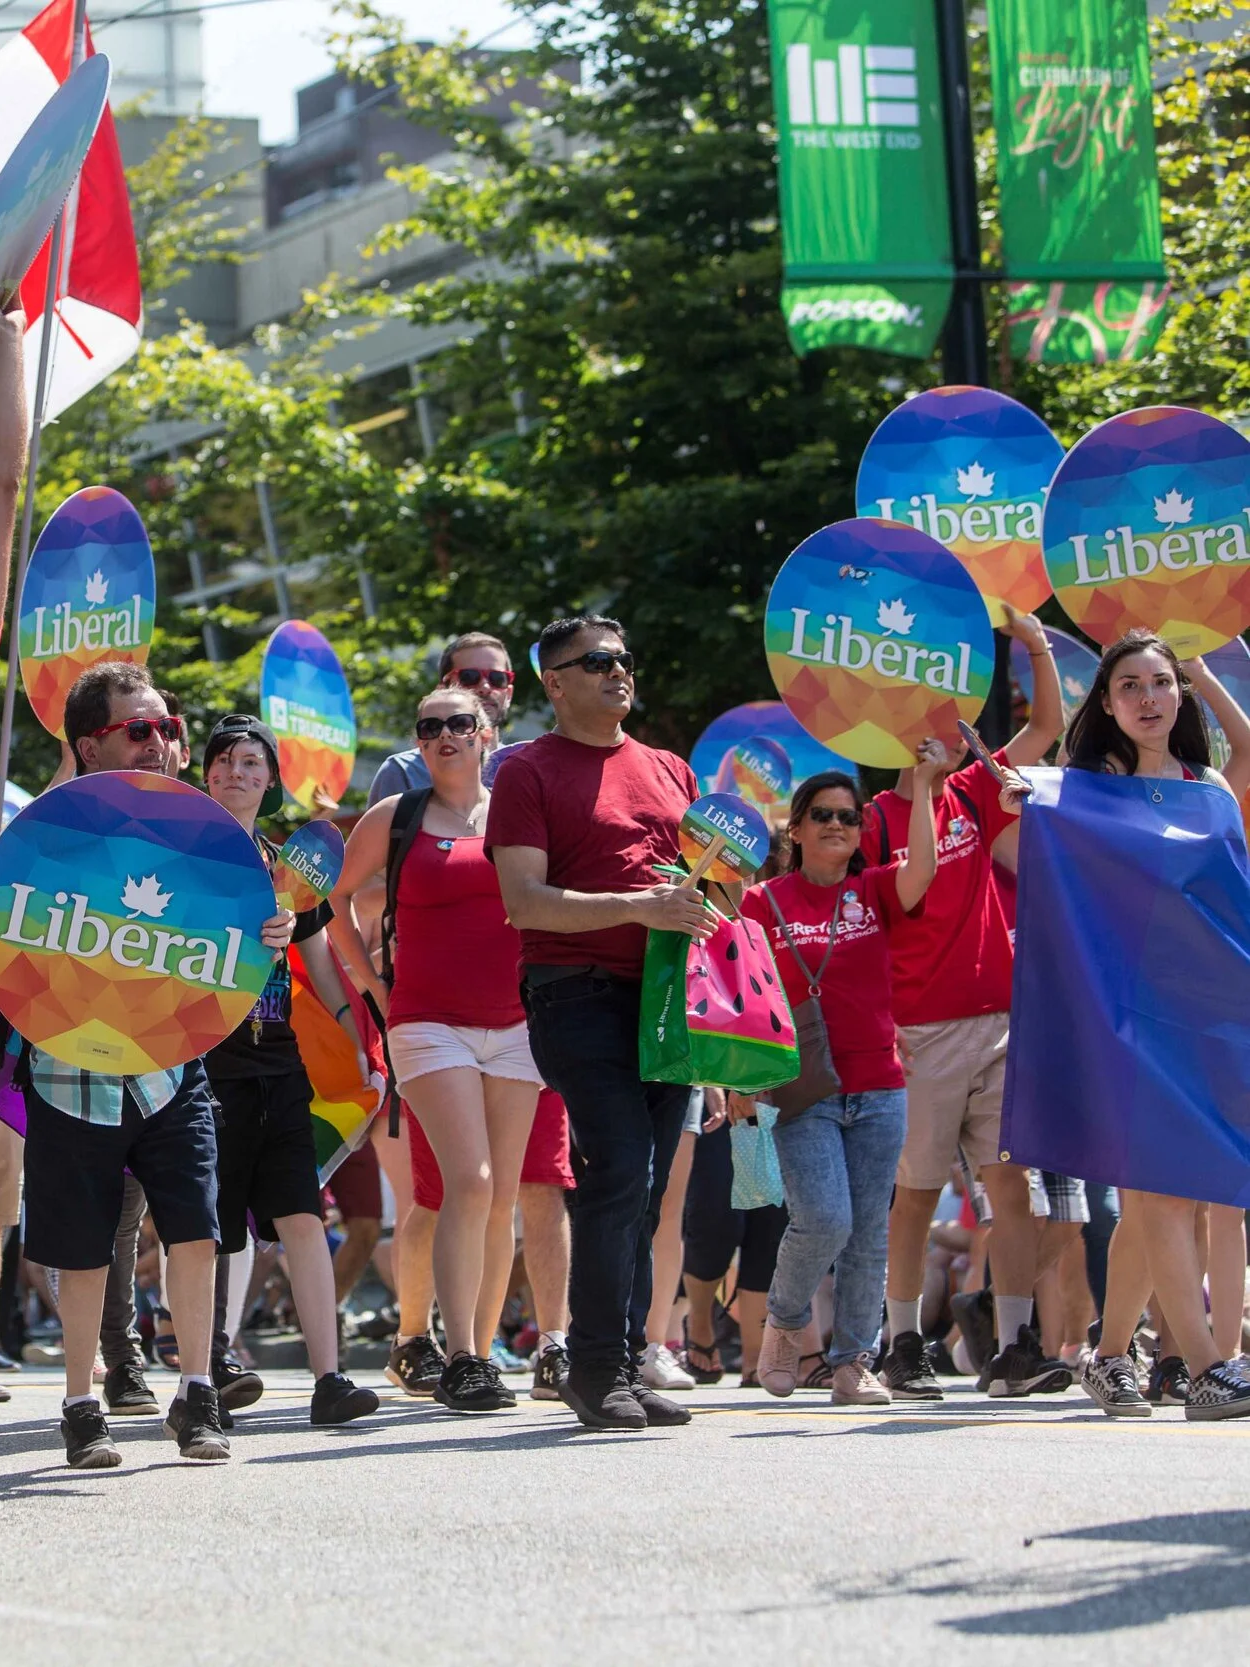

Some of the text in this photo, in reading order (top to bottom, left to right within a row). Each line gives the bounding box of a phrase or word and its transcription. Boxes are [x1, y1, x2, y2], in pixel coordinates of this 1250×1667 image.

[791, 130, 922, 149] THE WEST END
[1011, 79, 1138, 170] Light
[876, 486, 1051, 545] ibera
[32, 594, 141, 657] Liberal
[786, 607, 971, 695] Liberal
[288, 714, 350, 749] TRUDEAU
[741, 750, 783, 792] Liberal
[703, 804, 759, 851] Liberal
[287, 845, 329, 891] Liberal
[0, 882, 243, 989] Liberal
